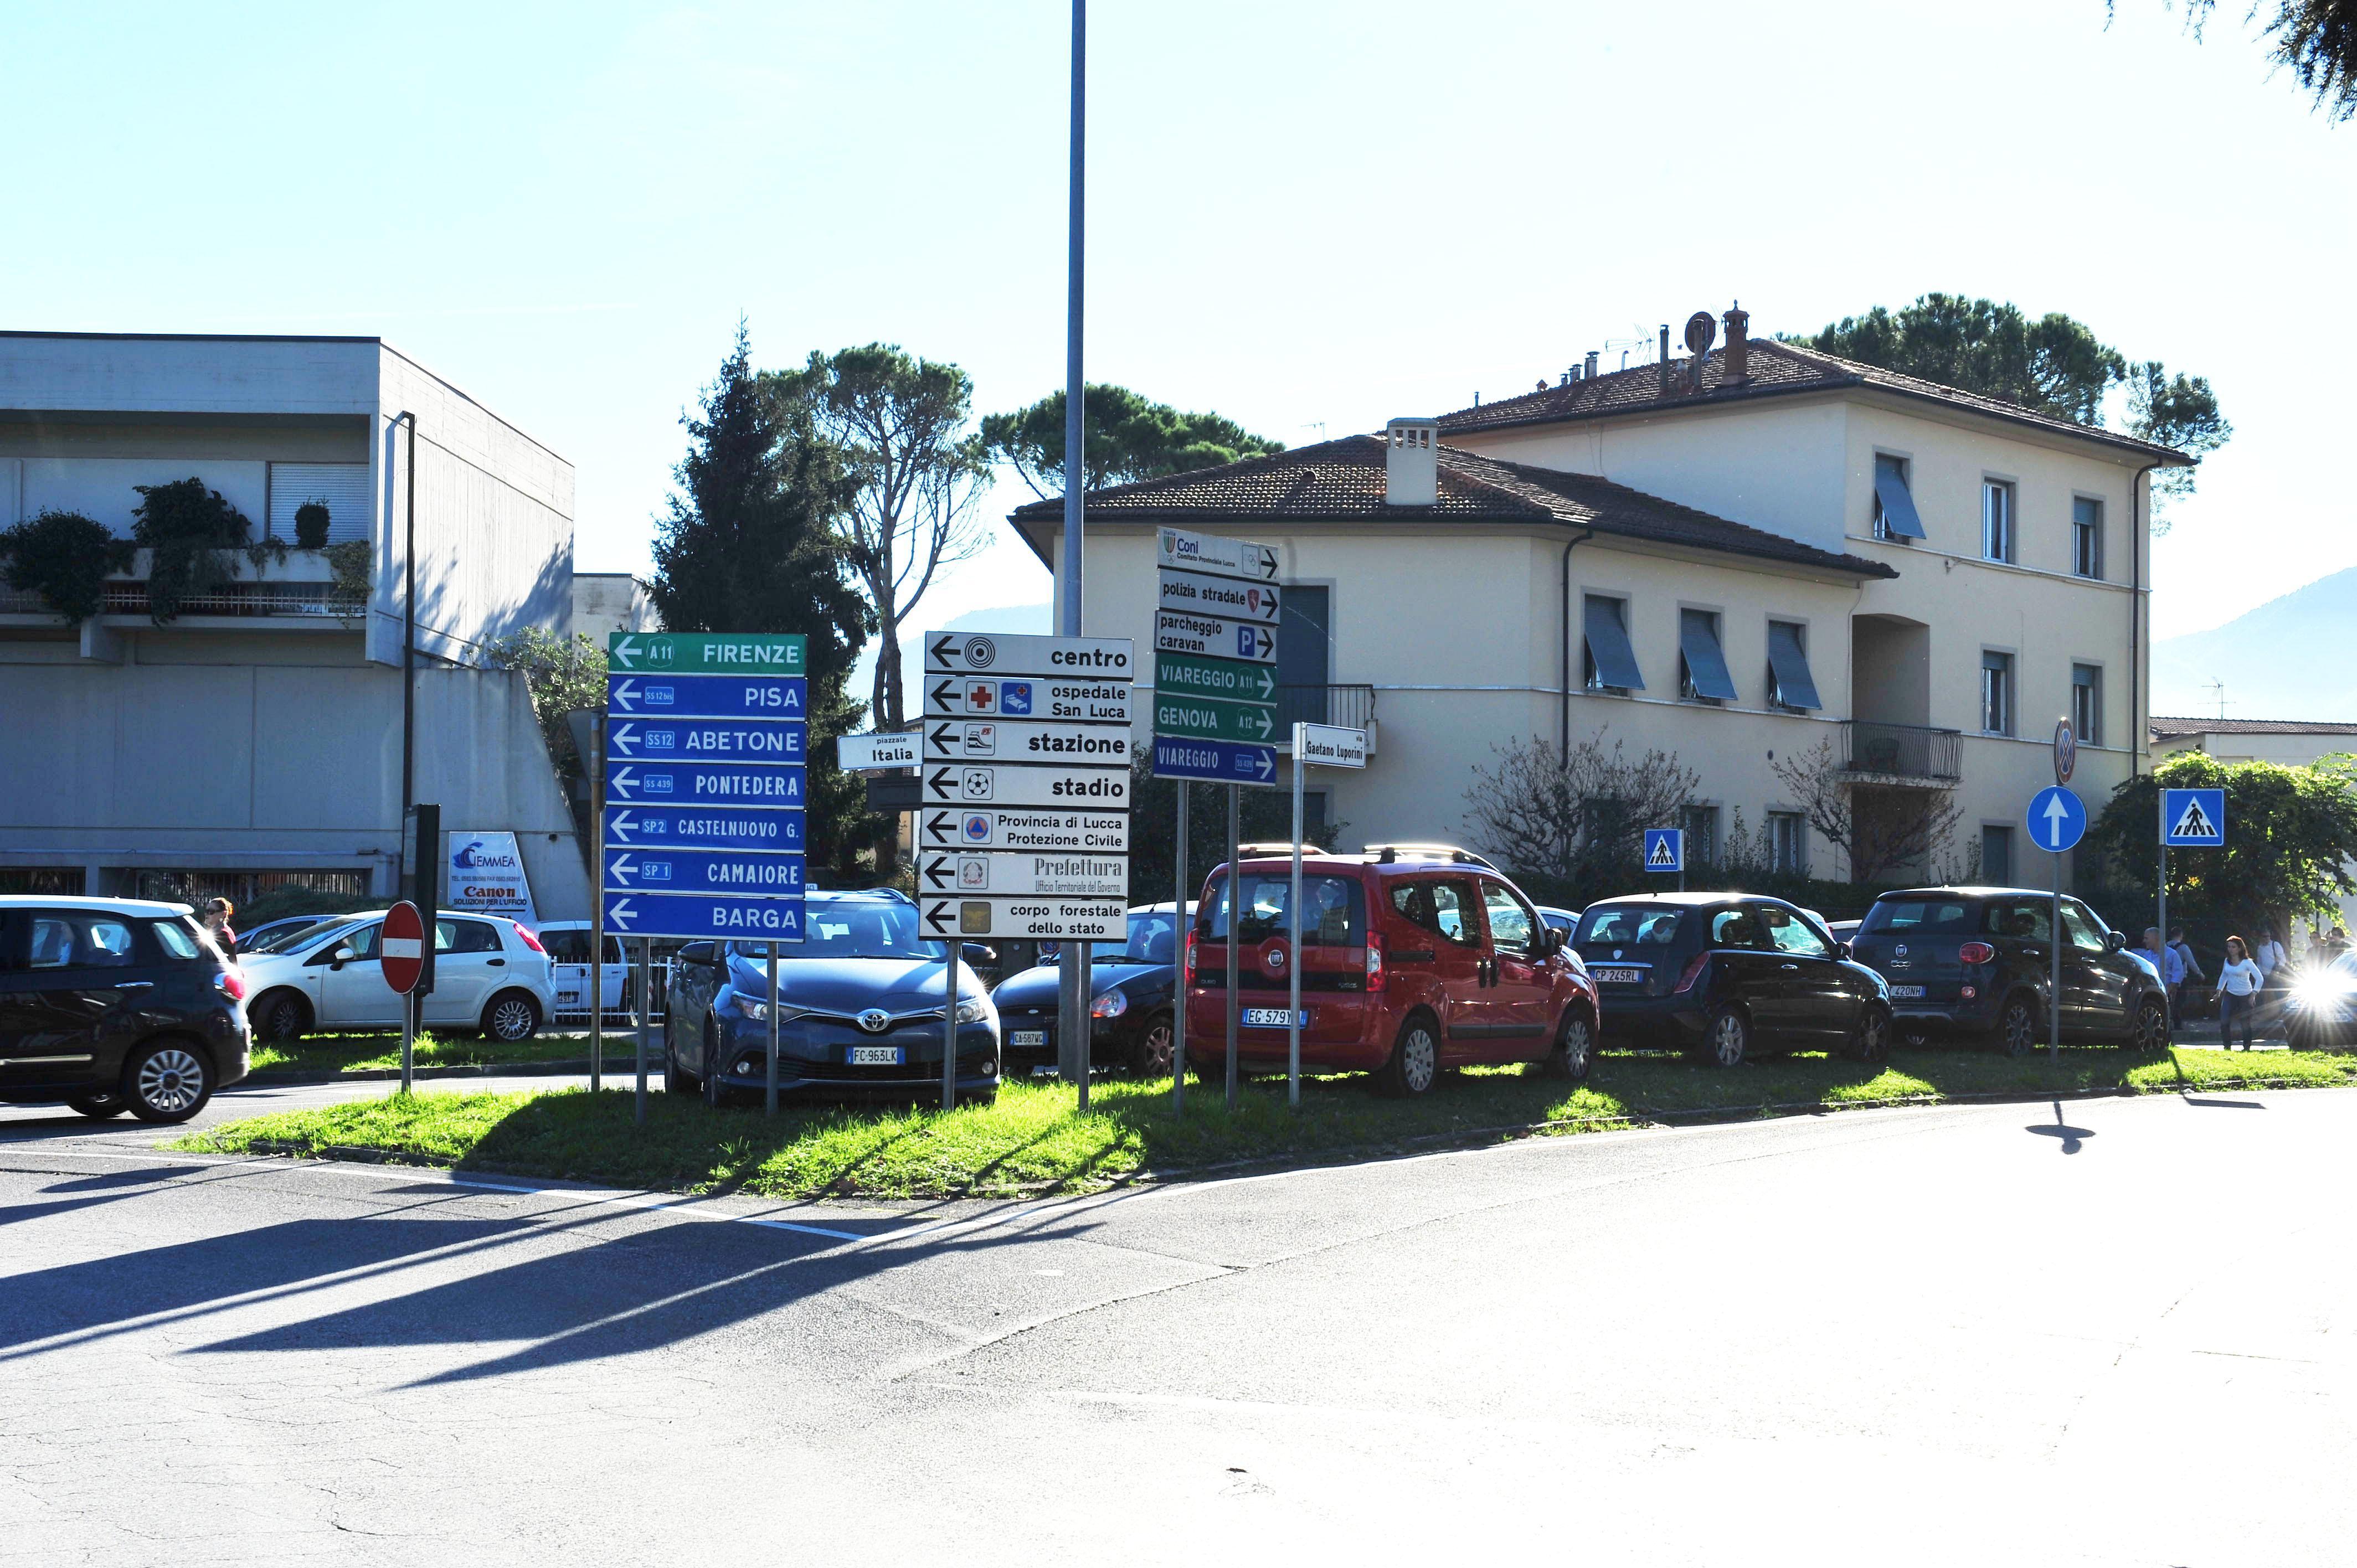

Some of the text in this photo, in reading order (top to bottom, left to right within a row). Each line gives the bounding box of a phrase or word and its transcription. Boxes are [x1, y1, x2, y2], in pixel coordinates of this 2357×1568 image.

[1177, 553, 1197, 561] Comitato
[1199, 556, 1222, 565] Provinciale
[1164, 583, 1245, 605] polizia stradale
[1161, 616, 1222, 636] parcheggio
[1160, 636, 1205, 651] caravan
[1242, 632, 1251, 652] P
[704, 644, 799, 663] FIRENZE
[1051, 649, 1127, 668] centro
[1161, 665, 1234, 688] VIAREGGIO
[745, 688, 799, 707] PISA
[1052, 686, 1125, 700] ospedale
[1052, 703, 1125, 718] San Luca
[1159, 706, 1217, 729] GENOVA
[686, 731, 799, 751] ABETONE
[1028, 734, 1125, 754] stazione
[1307, 740, 1362, 761] Gaetano Luporini
[872, 748, 913, 761] Italia
[1159, 746, 1218, 768] VIAREGGIO
[696, 775, 798, 796] PONTEDERA
[1052, 778, 1123, 797] stadio
[678, 820, 777, 837] CASTELNUOVO
[786, 823, 799, 838] G.
[999, 816, 1122, 829] Provincia di Lucca
[1007, 833, 1122, 847] Protezione Civile
[645, 864, 798, 884] SP 1 CAMAIORE
[1035, 858, 1121, 876] Prefettura
[464, 886, 515, 896] Canon
[1036, 880, 1120, 893] Ufficio Territoriale del Governo
[713, 907, 797, 929] BARGA
[1010, 905, 1121, 917] corpo forestale
[1028, 922, 1105, 935] dello stato
